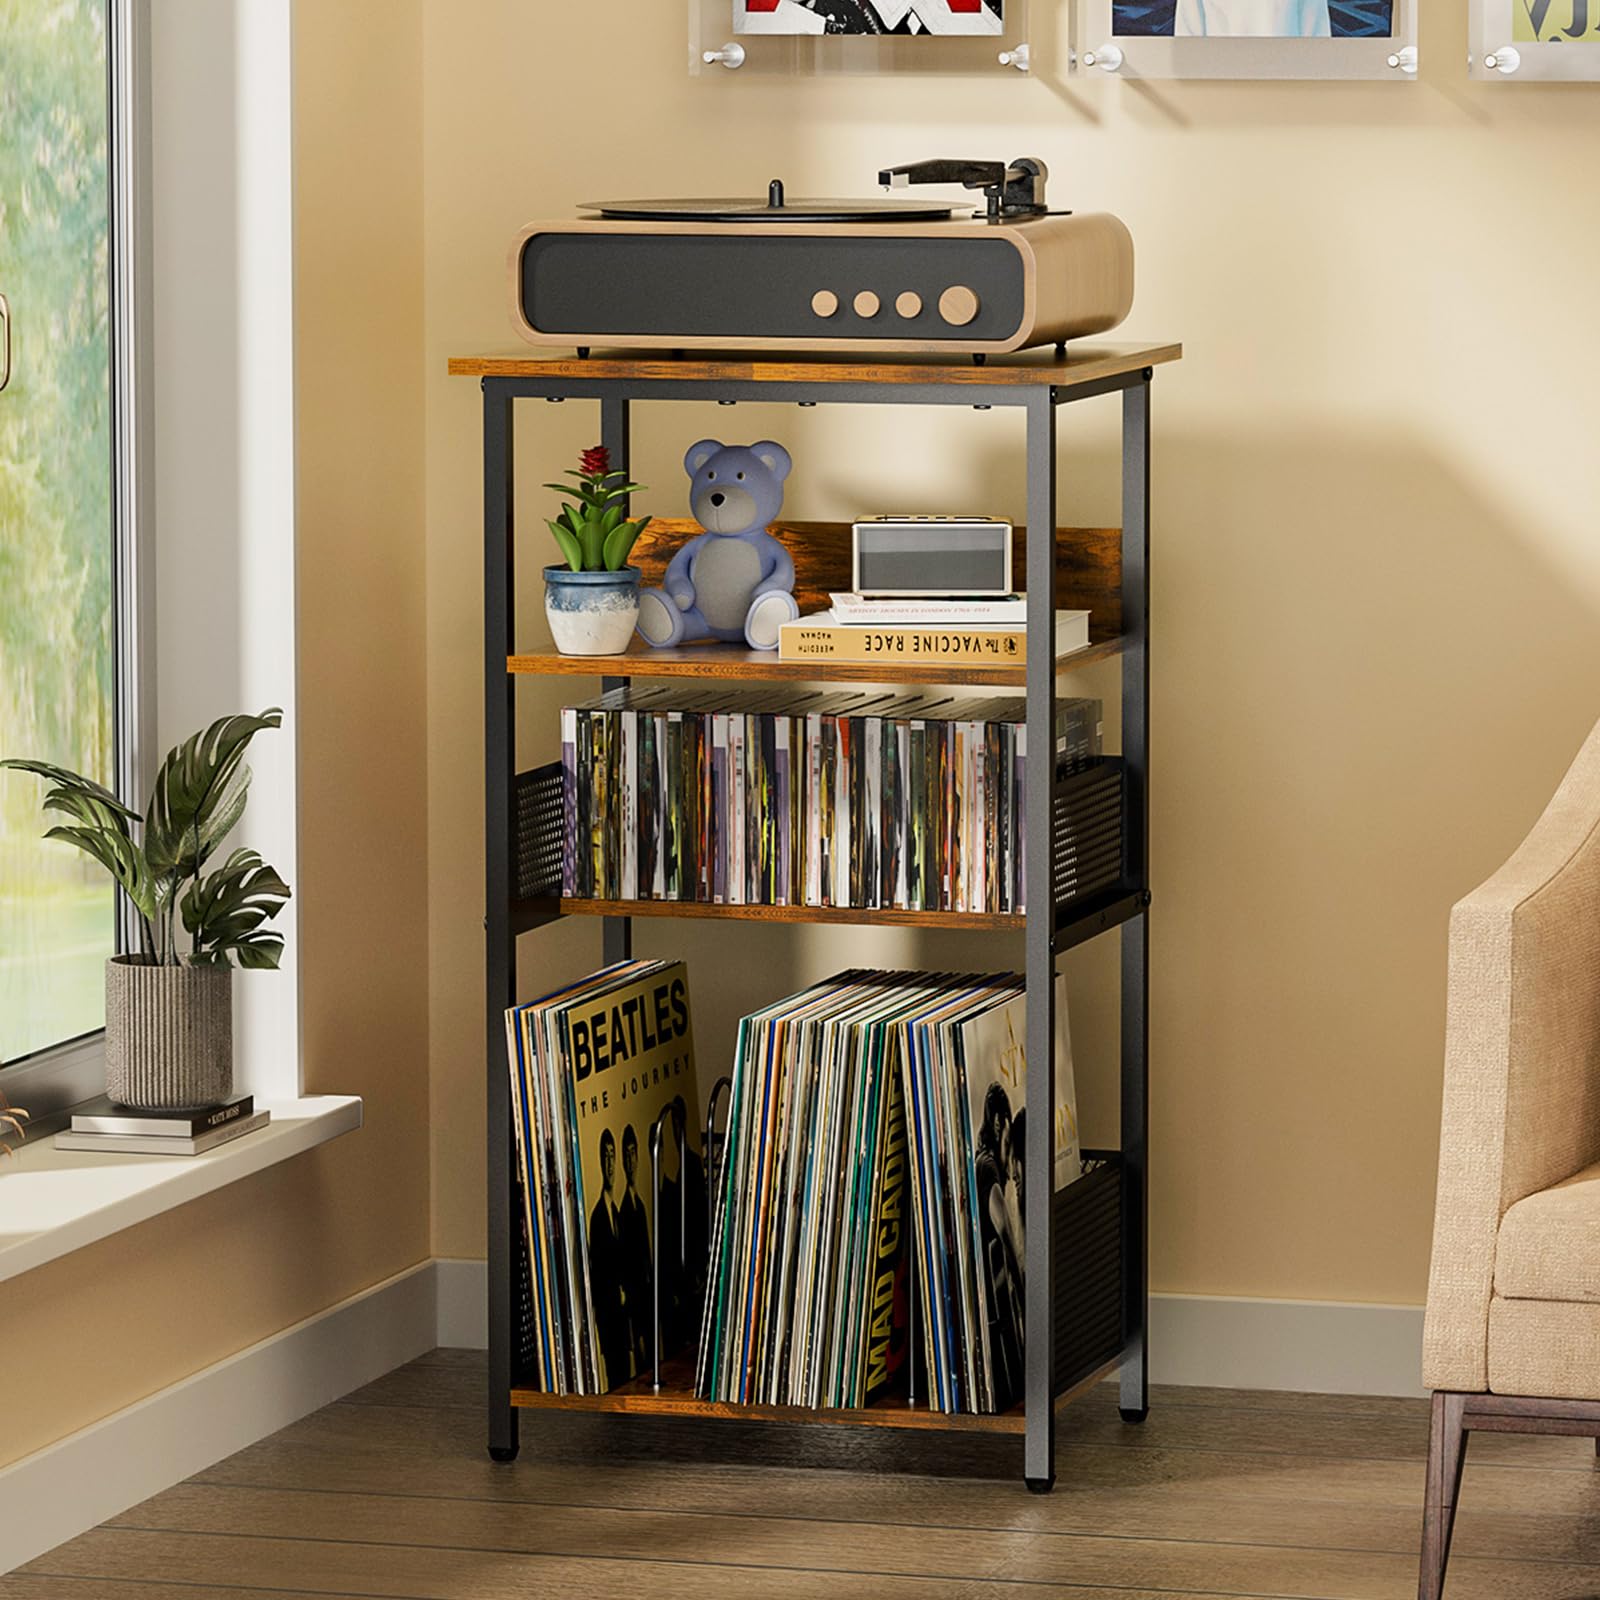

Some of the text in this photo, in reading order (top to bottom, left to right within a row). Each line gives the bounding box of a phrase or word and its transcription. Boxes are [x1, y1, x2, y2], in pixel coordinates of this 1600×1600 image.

[864, 634, 999, 653] The VACCINE RACE
[572, 978, 688, 1082] BEATLES
[580, 1053, 690, 1118] THE JOURNEY
[866, 1269, 895, 1393] MAD
